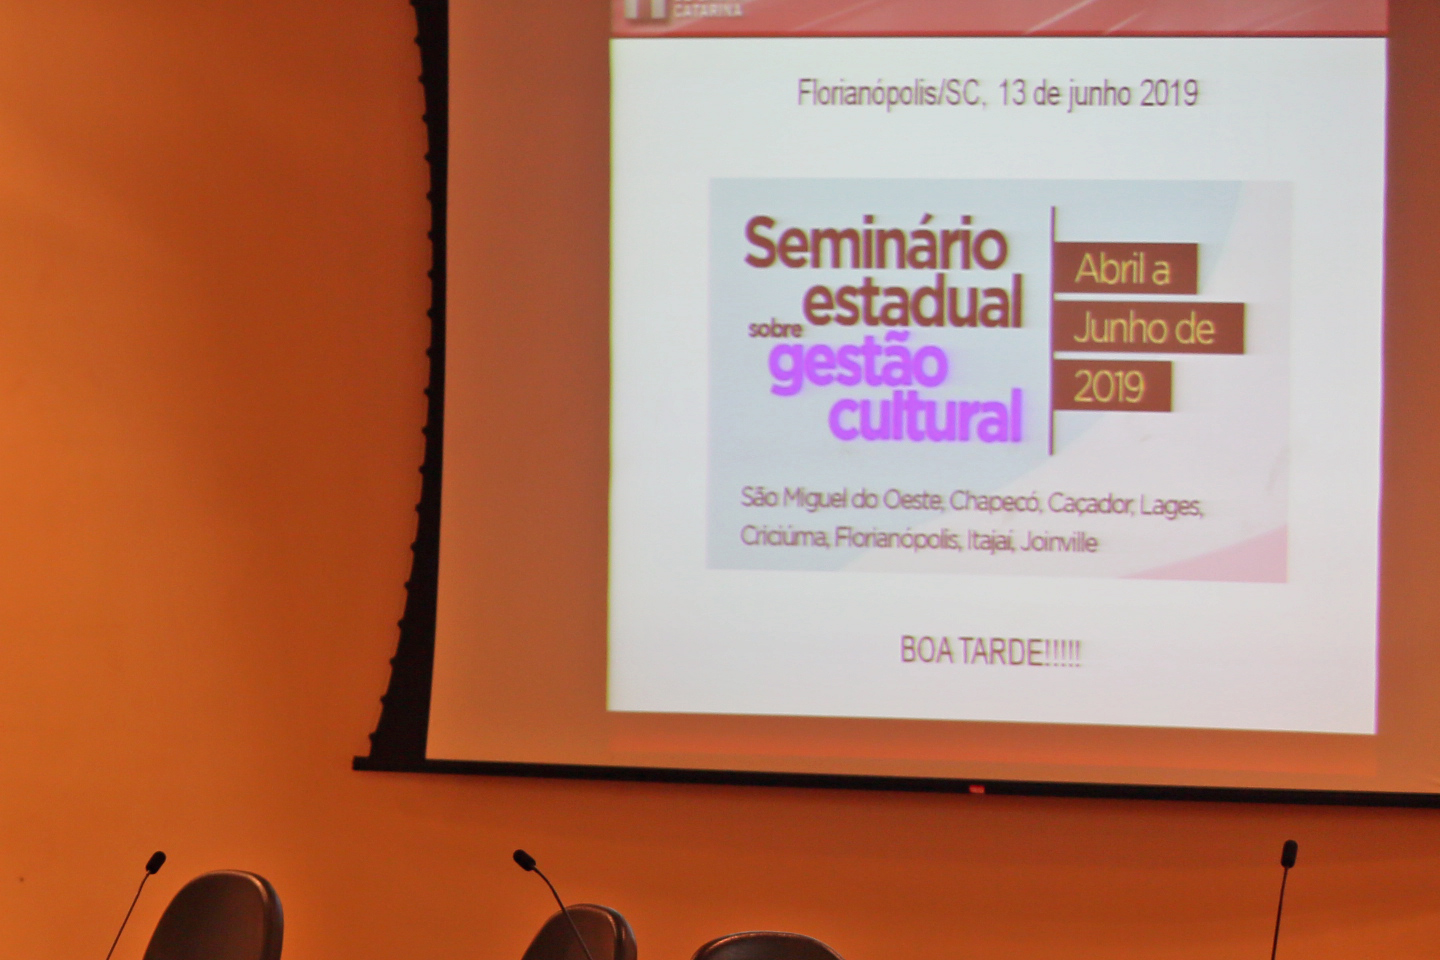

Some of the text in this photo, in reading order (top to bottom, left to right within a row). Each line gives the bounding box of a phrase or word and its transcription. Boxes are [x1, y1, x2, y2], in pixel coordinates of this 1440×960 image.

[675, 4, 743, 17] CATARINA
[797, 76, 1200, 113] Florianópolis/SC, 13 de junho 2019
[743, 212, 1009, 271] Seminário
[1074, 250, 1172, 286] Abril a
[802, 271, 1023, 329] estadual
[748, 317, 803, 339] sobre
[1073, 311, 1216, 345] Junho de
[769, 328, 949, 397] gestão
[1073, 369, 1145, 404] 2019
[828, 386, 1023, 445] cultural
[741, 485, 1204, 520] São Miguel do Oeste, Chapecó, Caçador, Lages,
[740, 523, 1100, 555] Criciúma, Florianópolis, Itajaí, Joinville
[900, 635, 1082, 667] BOA TARDE!!!!!
